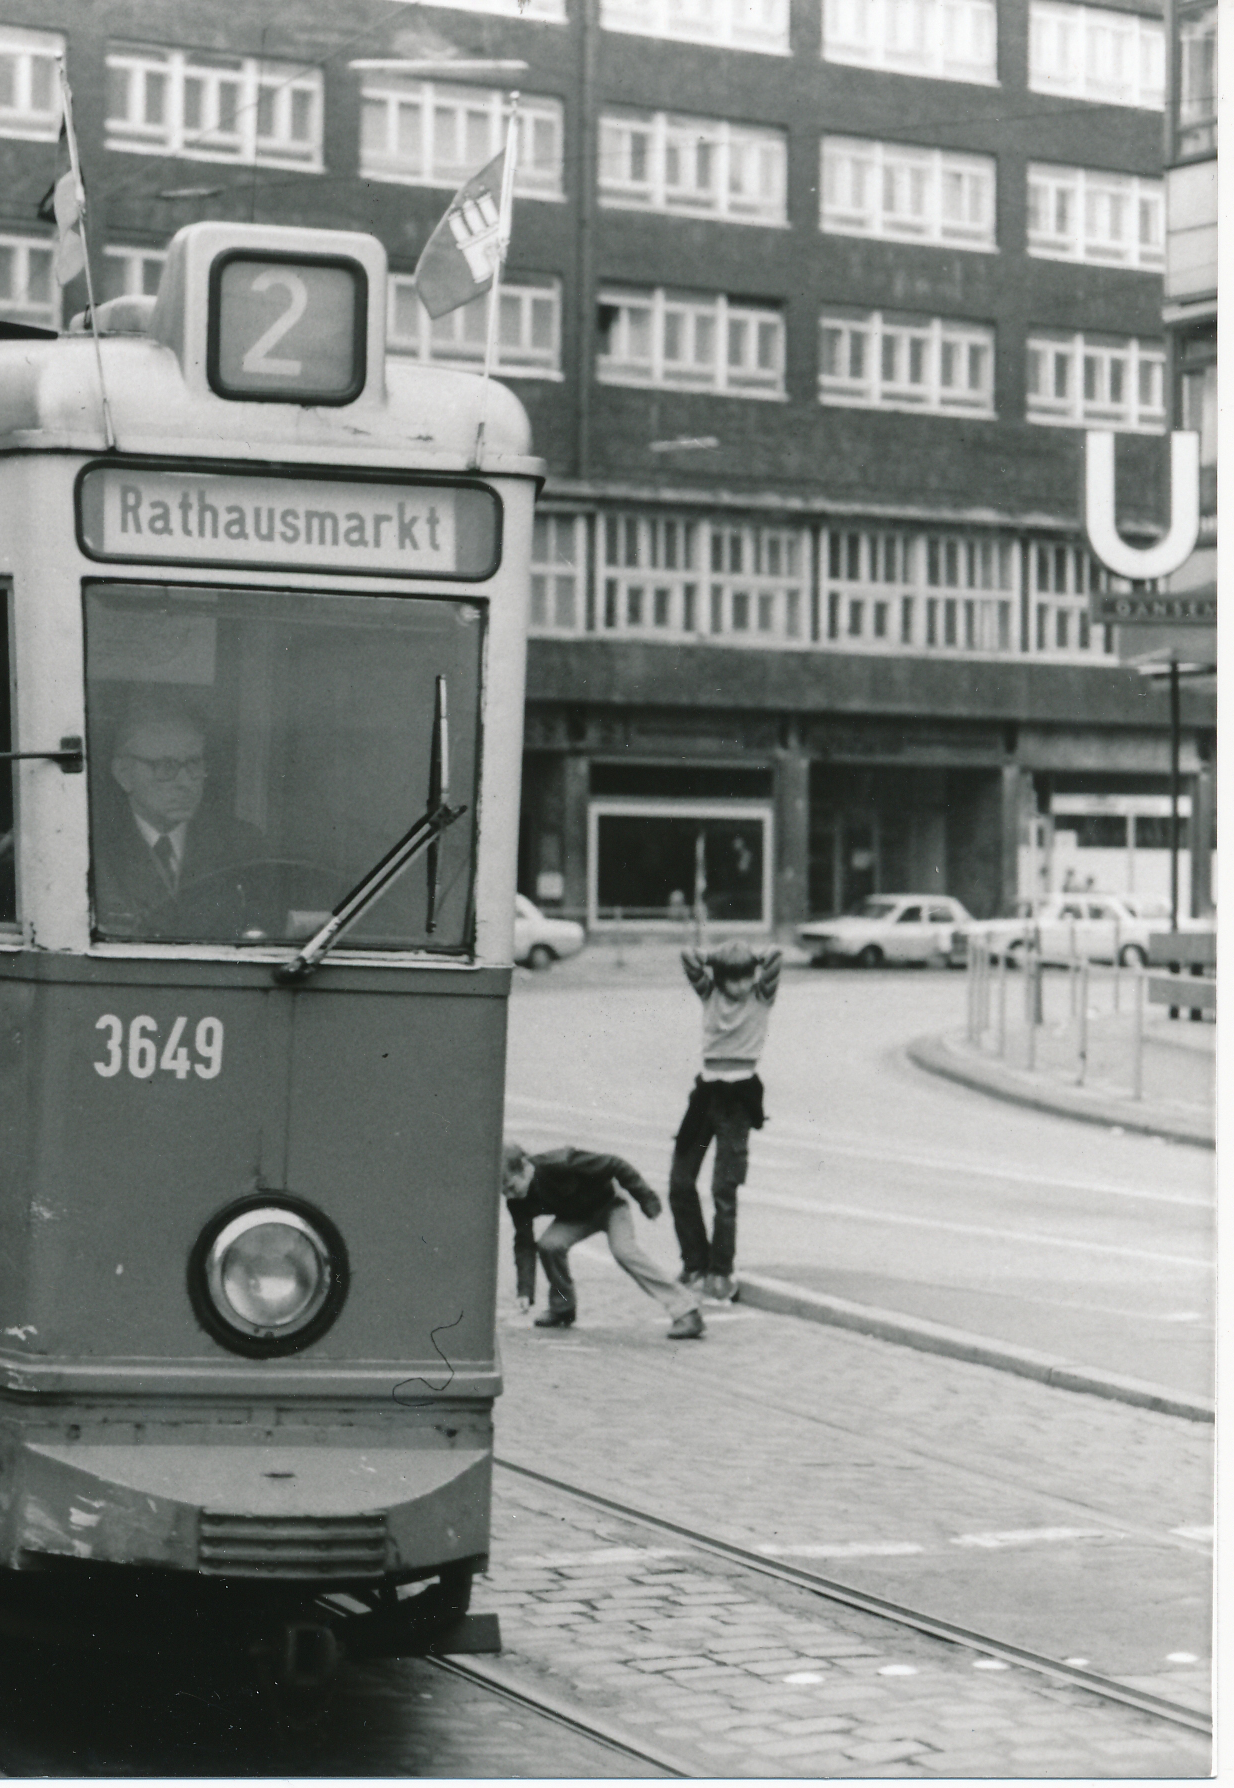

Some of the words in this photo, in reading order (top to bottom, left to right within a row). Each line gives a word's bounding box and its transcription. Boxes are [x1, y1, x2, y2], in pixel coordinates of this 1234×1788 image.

[242, 268, 308, 377] 2
[119, 484, 441, 552] Rathausmarkt
[1086, 430, 1200, 579] U
[93, 1013, 224, 1080] 3649
